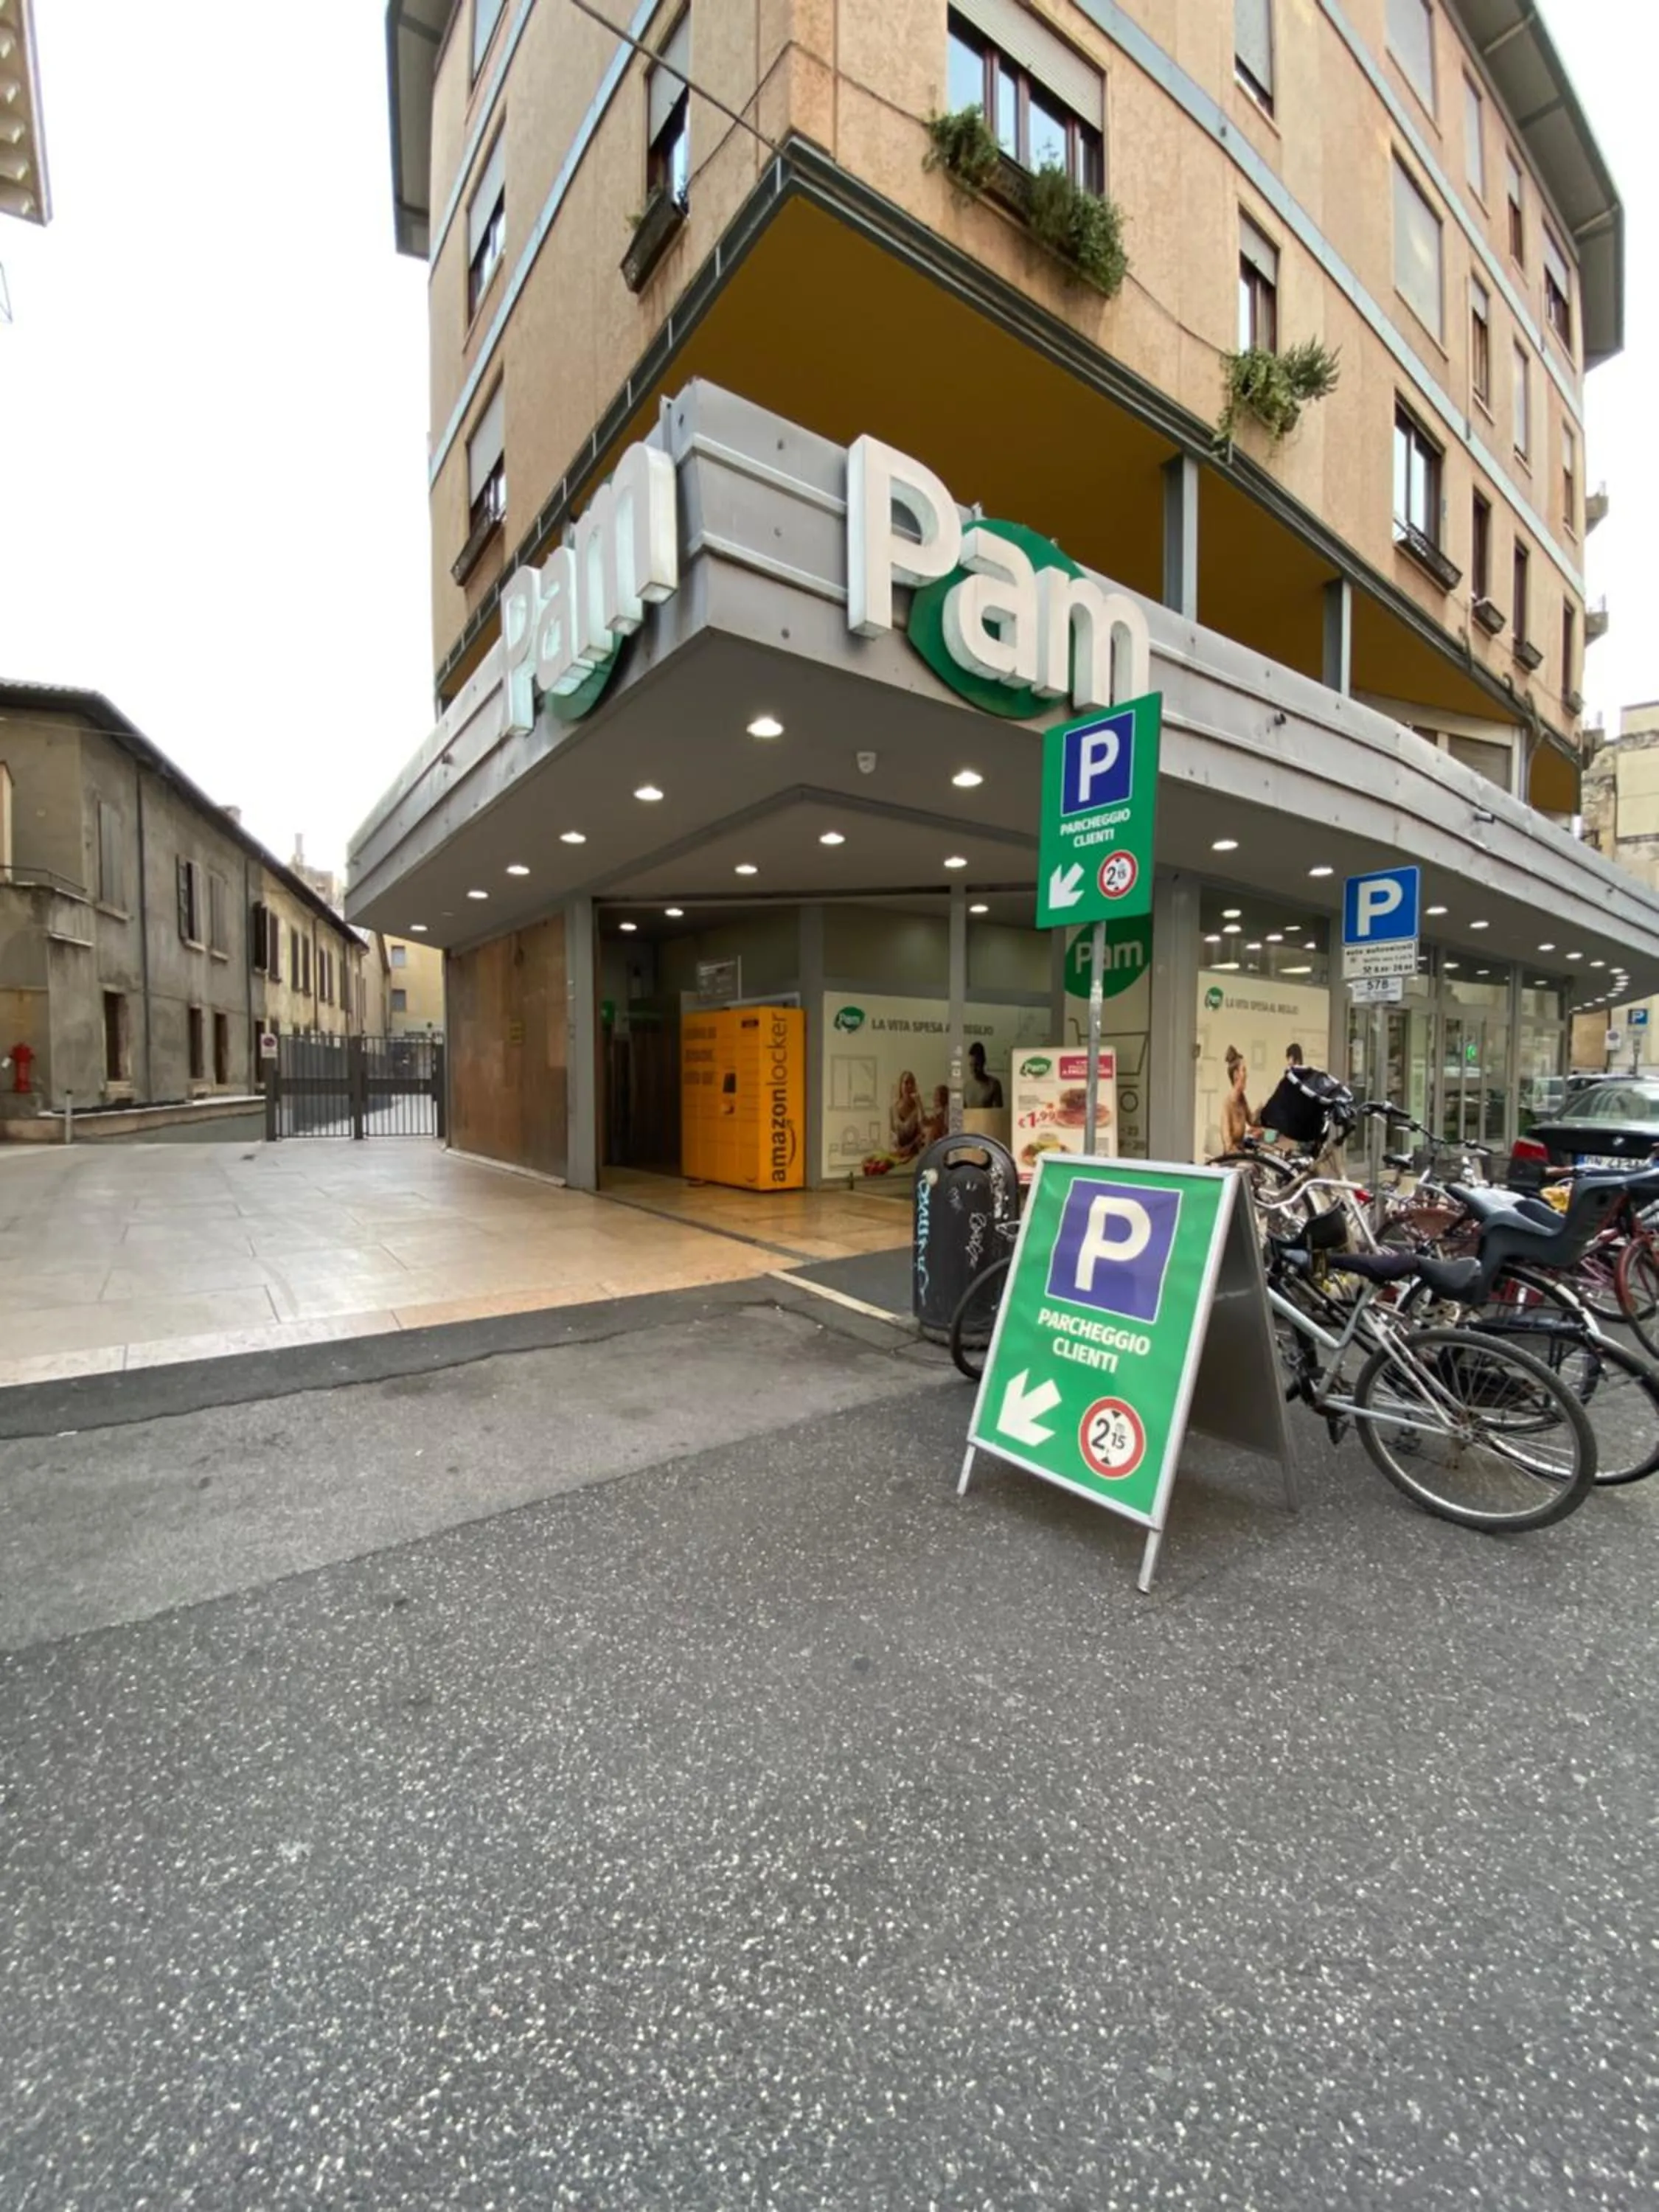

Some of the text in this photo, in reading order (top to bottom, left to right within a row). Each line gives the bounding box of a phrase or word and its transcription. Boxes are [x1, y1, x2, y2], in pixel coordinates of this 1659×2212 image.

[501, 442, 678, 737] Pam
[848, 434, 1150, 709] Pam
[1079, 729, 1120, 802] P
[1059, 807, 1131, 836] PARCHEGGIO
[1073, 828, 1115, 849] CLIENTI
[1357, 878, 1404, 937] P
[872, 1018, 884, 1029] LA
[887, 1019, 910, 1032] VITA
[913, 1021, 944, 1033] SPESA
[1632, 1013, 1645, 1023] P
[1074, 1195, 1152, 1292] P
[1037, 1307, 1151, 1355] PARCHEGGIO
[1052, 1337, 1119, 1374] CLIENTI
